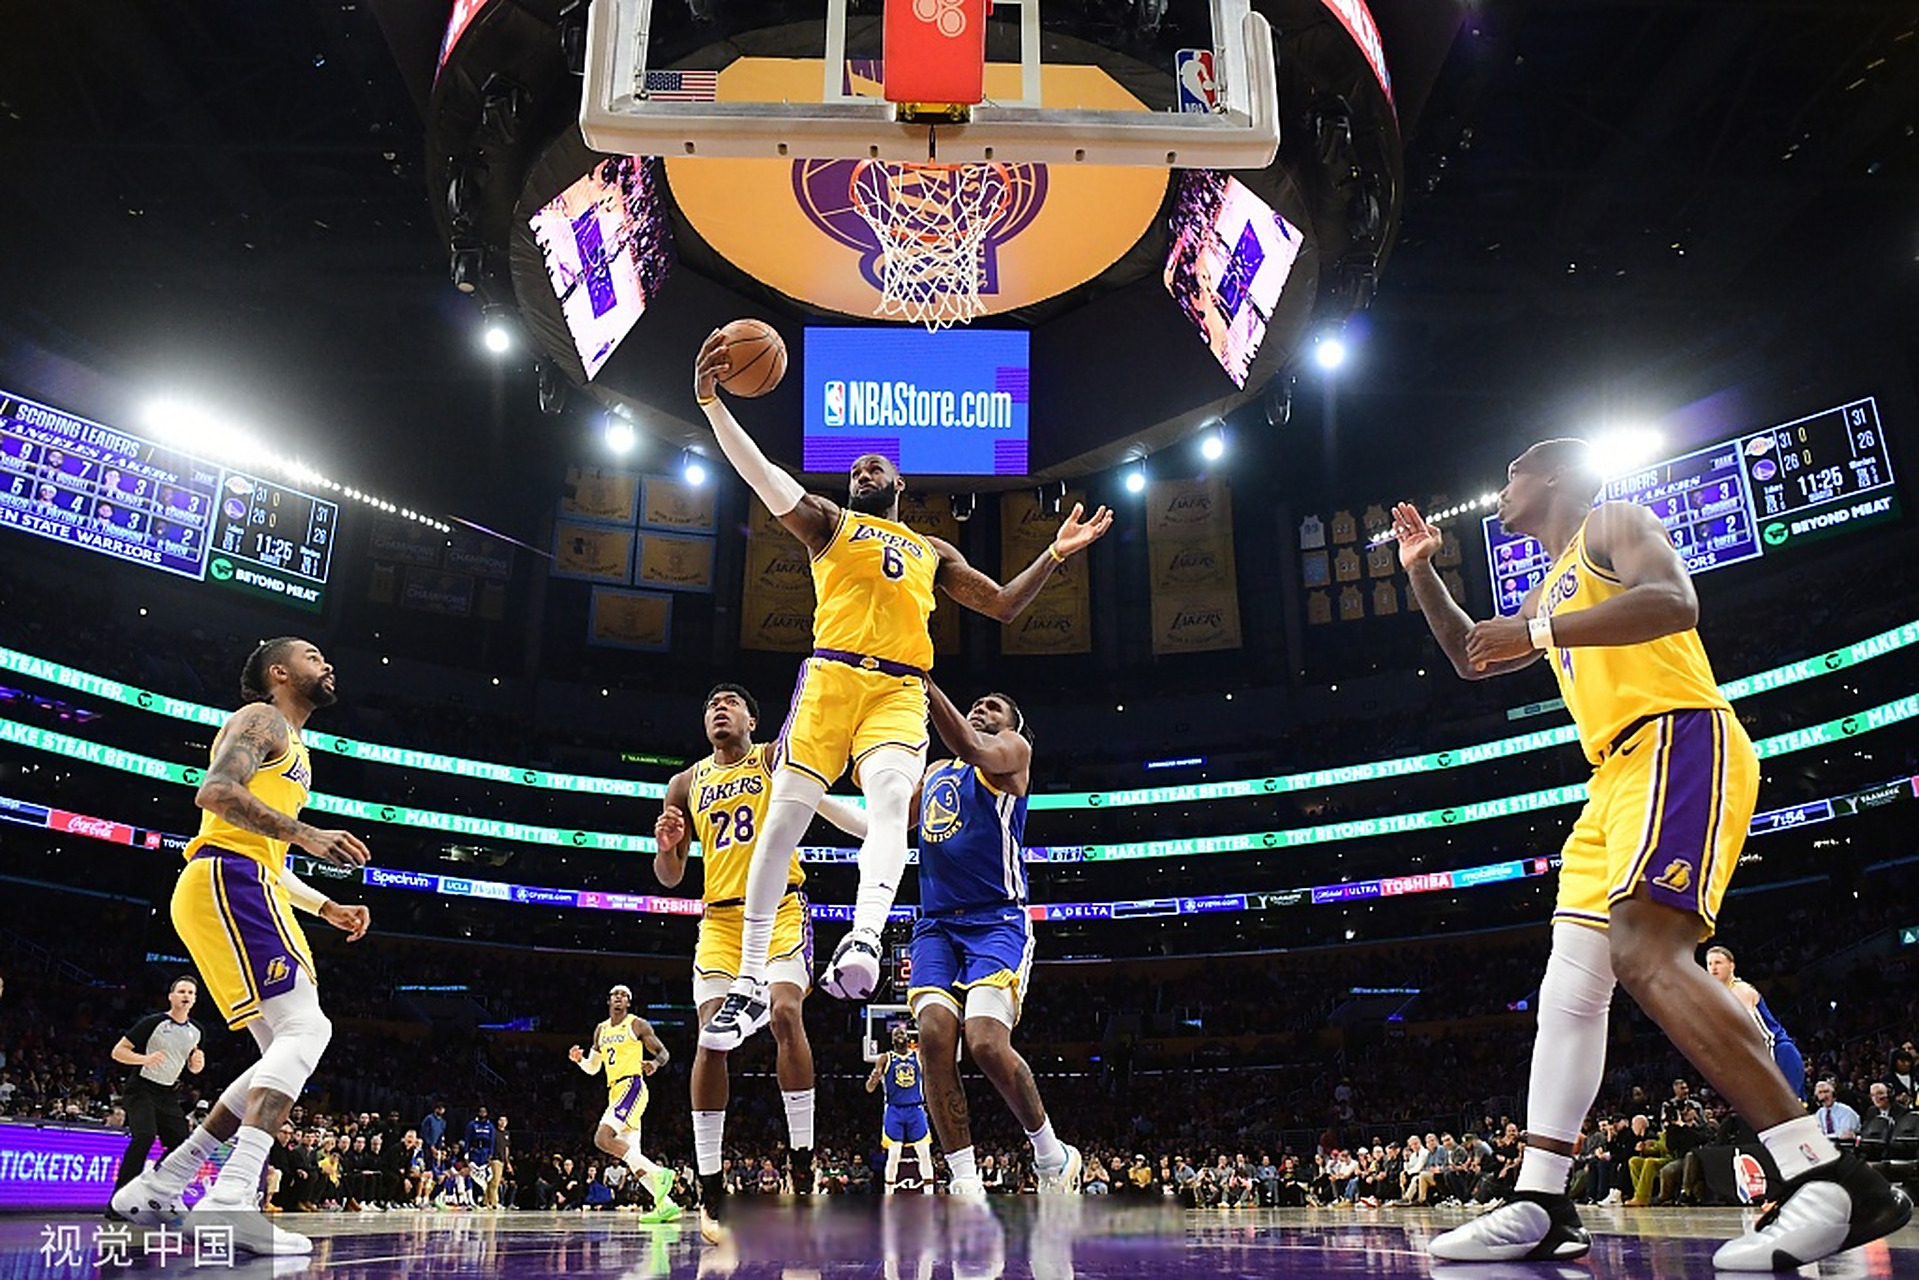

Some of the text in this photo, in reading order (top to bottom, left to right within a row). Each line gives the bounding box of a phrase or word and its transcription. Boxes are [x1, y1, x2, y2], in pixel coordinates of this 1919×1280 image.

[849, 381, 1011, 428] NBAStore.com
[1851, 408, 1866, 426] 31
[16, 404, 139, 458] SCORING LEADERS
[1779, 427, 1807, 448] 31 0
[20, 443, 33, 460] 9
[1802, 449, 1812, 465] 0
[80, 461, 92, 478] 7
[135, 480, 146, 496] 3
[1608, 470, 1658, 499] LEADERS
[1719, 482, 1729, 499] 3
[71, 496, 84, 512] 4
[188, 497, 199, 512] 3
[273, 493, 280, 507] 0
[1668, 498, 1677, 514] 3
[128, 513, 140, 529] 3
[269, 513, 276, 528] 0
[1726, 515, 1736, 533] 2
[1791, 496, 1893, 535] BEYOND MEAT
[22, 515, 71, 537] STATE
[77, 526, 162, 563] WARRIORS
[182, 529, 194, 546] 2
[849, 524, 923, 559] LAKERS
[1674, 530, 1683, 547] 3
[1525, 541, 1533, 557] 9
[881, 546, 905, 580] 6
[236, 568, 320, 602] BEYOND MEAT
[1851, 633, 1900, 664] MAKE
[0, 647, 127, 702] STEAK BETTER.
[1754, 663, 1815, 692] STEAK.
[164, 701, 195, 720] TRY
[1866, 696, 1919, 729] MAKE
[1460, 743, 1501, 762] MAKE
[1504, 732, 1551, 754] STEAK
[1767, 724, 1831, 755] STEAK.
[0, 721, 171, 780] AKE STEAK BETTER.
[357, 743, 513, 782] MAKE STEAK BETTER.
[1286, 756, 1428, 790] TRY BEYOND STEAK.
[546, 773, 573, 790] TRY
[577, 776, 634, 795] BEYOND
[1109, 779, 1255, 806] MAKE STEAK BETTER.
[697, 776, 763, 814] LAKERS
[945, 790, 953, 807] 5
[317, 798, 371, 818] STEAK.
[1464, 801, 1507, 819] MAKE
[1510, 792, 1560, 812] STEAK
[405, 811, 563, 845] MAKE STEAK BETTER.
[710, 805, 754, 850] 28
[1771, 810, 1806, 827] 7:54
[1285, 812, 1432, 845] TRY BEYOND STEAK.
[597, 834, 624, 850] TRY
[1105, 835, 1254, 861] MAKE STEAK BETTER.
[373, 870, 428, 887] Spectrum
[447, 879, 469, 891] UCLA
[1384, 875, 1449, 893] TOSHIBA
[1350, 884, 1378, 896] ULTRA
[653, 899, 703, 913] TOSHIB
[812, 908, 844, 917] ELTA
[1065, 907, 1108, 916] DELTA
[607, 1047, 615, 1065] 2
[0, 1150, 85, 1181] TICKETS
[86, 1156, 113, 1182] AT
